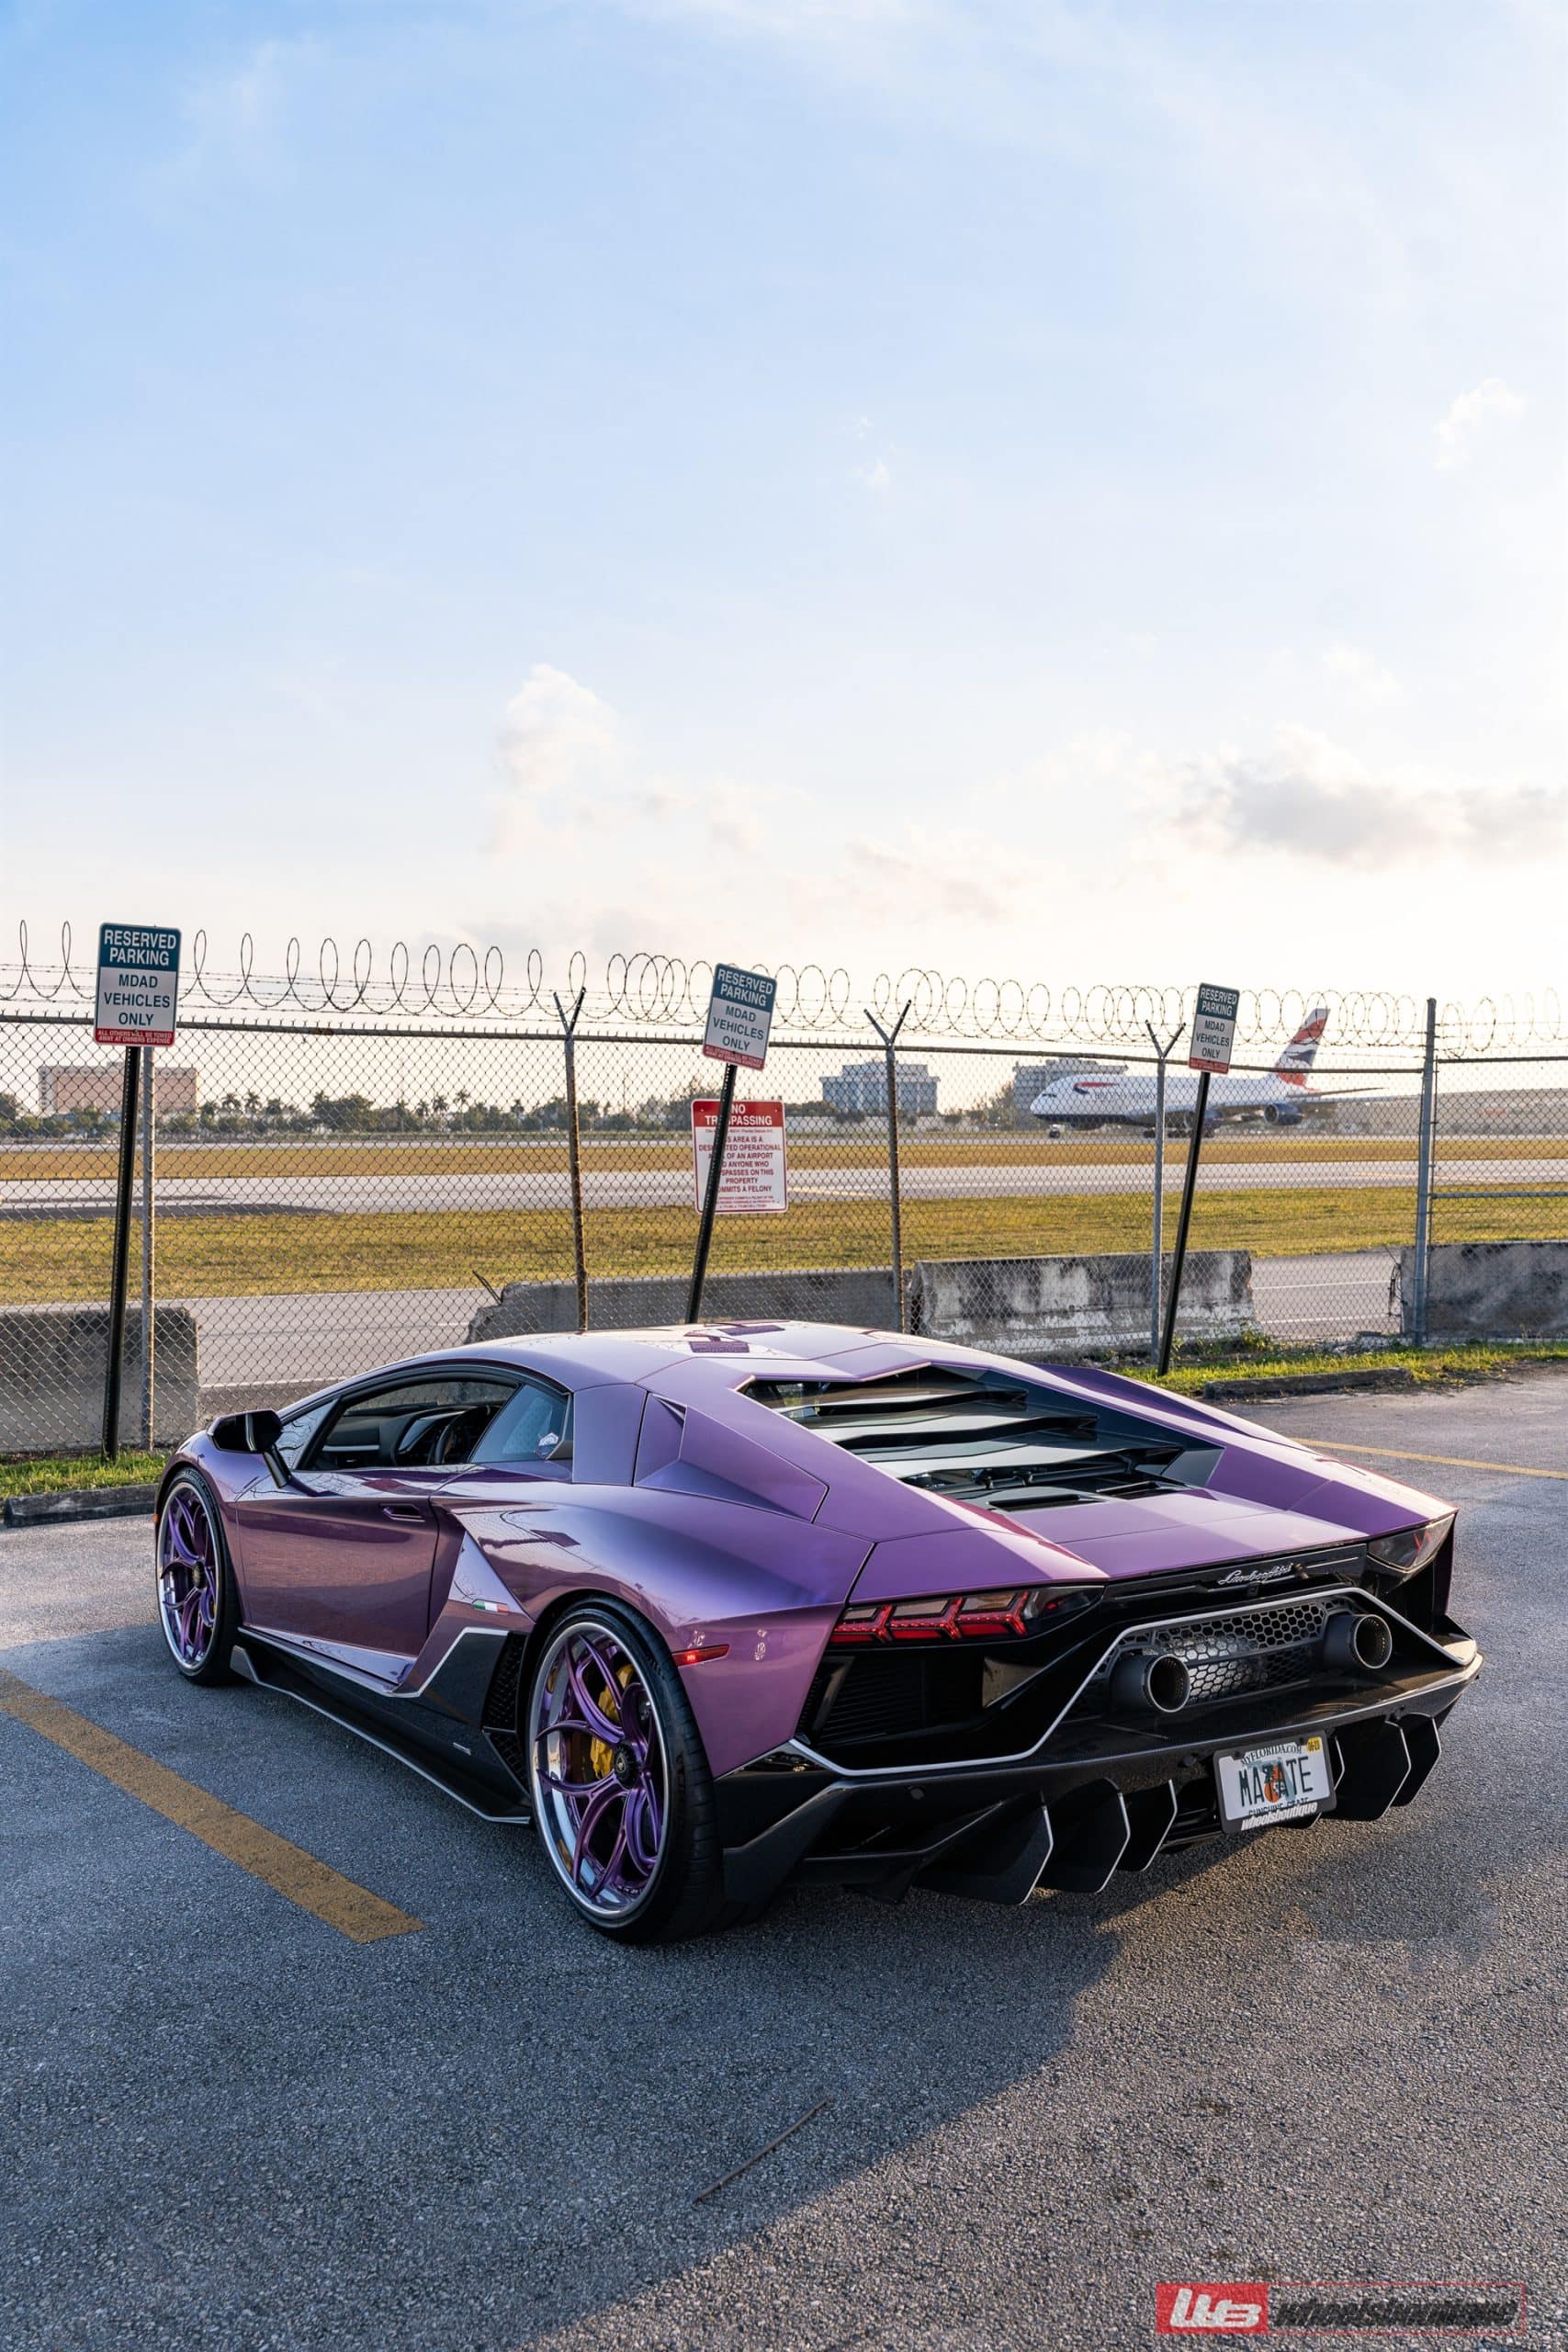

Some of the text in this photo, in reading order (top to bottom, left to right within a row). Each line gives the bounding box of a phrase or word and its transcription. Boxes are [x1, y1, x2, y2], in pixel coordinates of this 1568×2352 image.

[104, 930, 176, 949] RESERVED
[109, 948, 169, 966] PARKING
[118, 974, 158, 989] MDAD
[717, 969, 773, 994] RESERVED
[104, 992, 170, 1008] VEHICLES
[720, 984, 766, 1007] PARKING
[1200, 988, 1237, 1005] RESERVED
[726, 1005, 756, 1023] MDAD
[1201, 1001, 1233, 1016] PARKING
[118, 1012, 154, 1026] ONLY
[1204, 1020, 1225, 1033] MDAD
[713, 1017, 764, 1040] VEHICLES
[722, 1035, 750, 1051] ONLY
[1196, 1033, 1230, 1046] VEHICLES
[1201, 1047, 1221, 1059] ONLY
[731, 1103, 746, 1114] NO
[705, 1115, 773, 1125] TRPASSING
